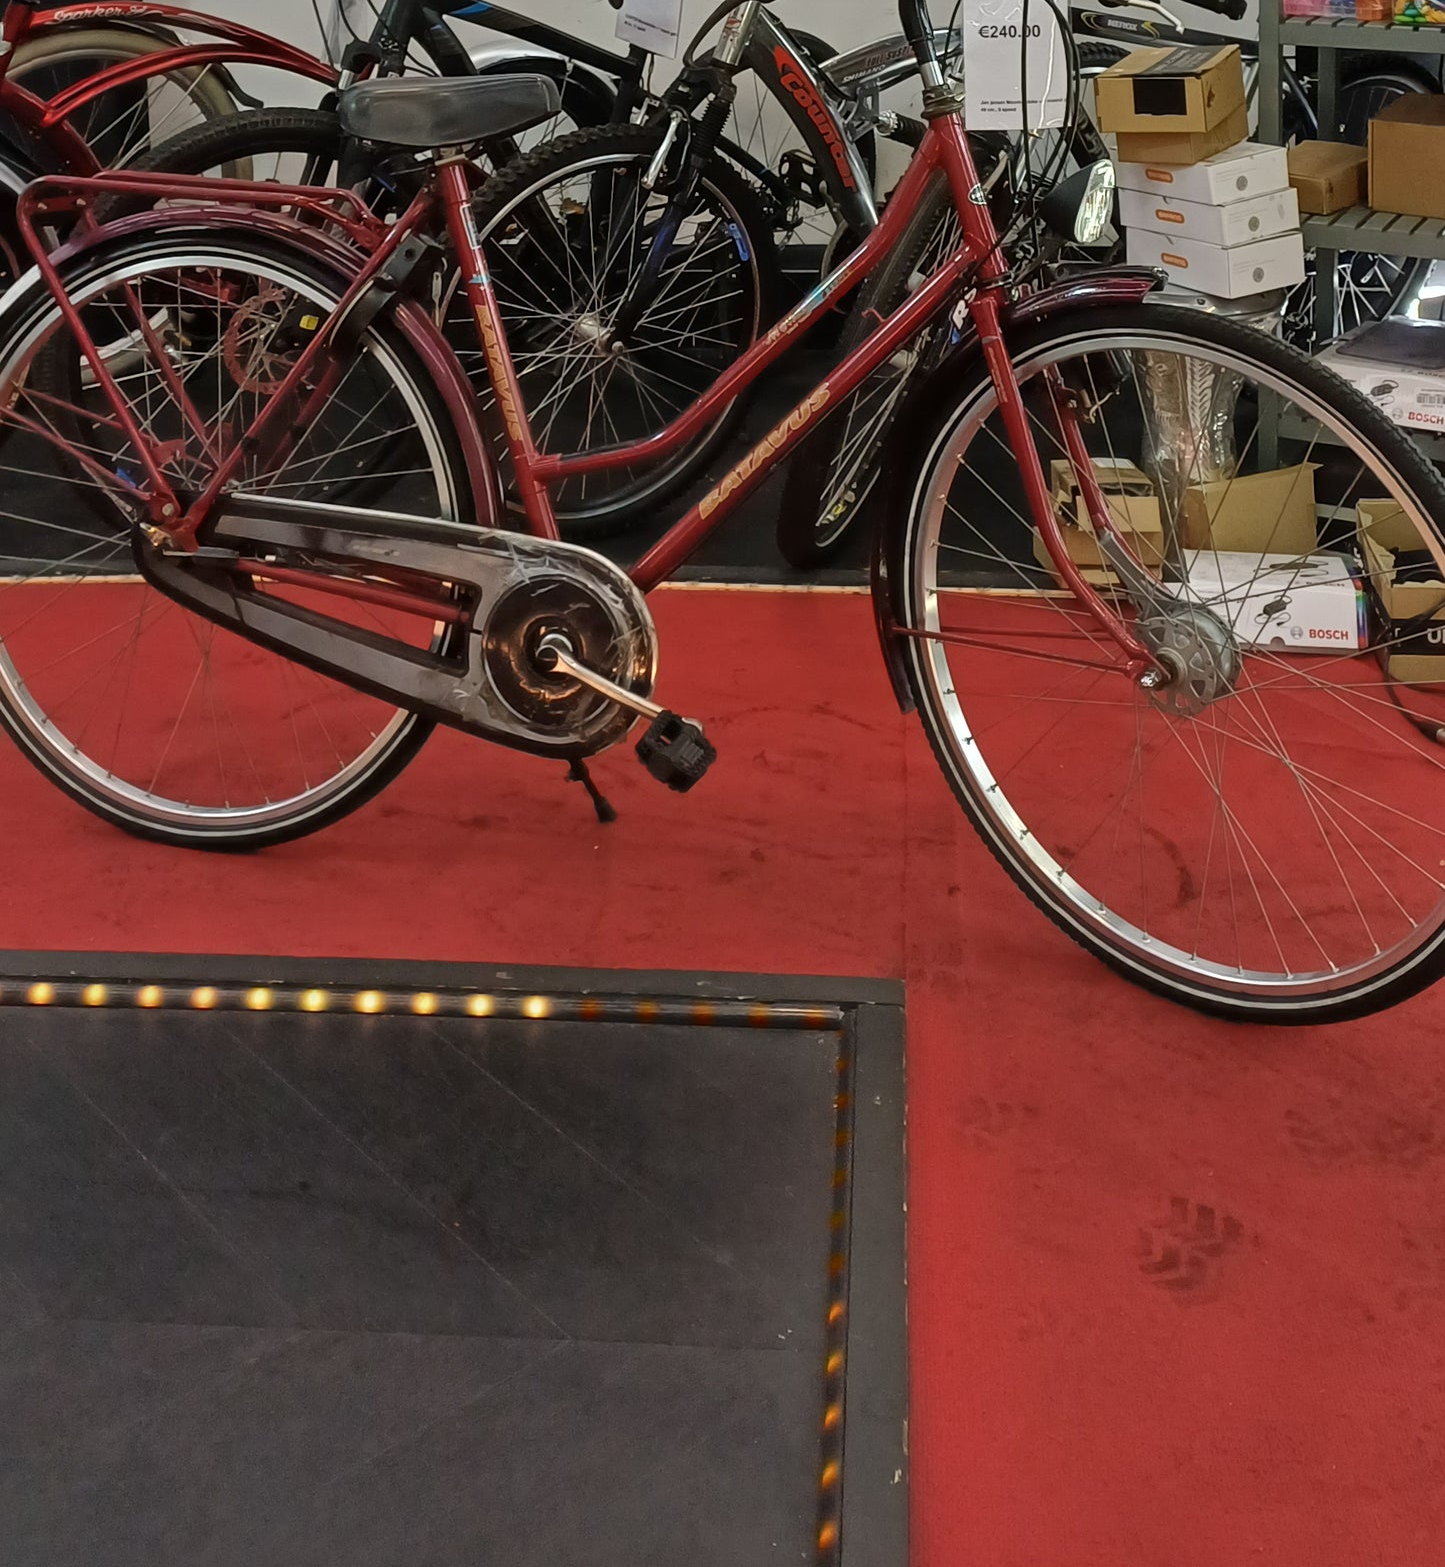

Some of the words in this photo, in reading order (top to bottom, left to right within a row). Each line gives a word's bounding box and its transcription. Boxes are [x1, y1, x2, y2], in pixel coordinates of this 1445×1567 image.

[978, 24, 1041, 39] €240.00
[842, 64, 887, 83] SHIMANO
[475, 304, 524, 441] BATAVUS
[1408, 411, 1445, 425] BOSCH
[699, 383, 830, 521] BATAVUS
[1308, 628, 1349, 641] BOSCH
